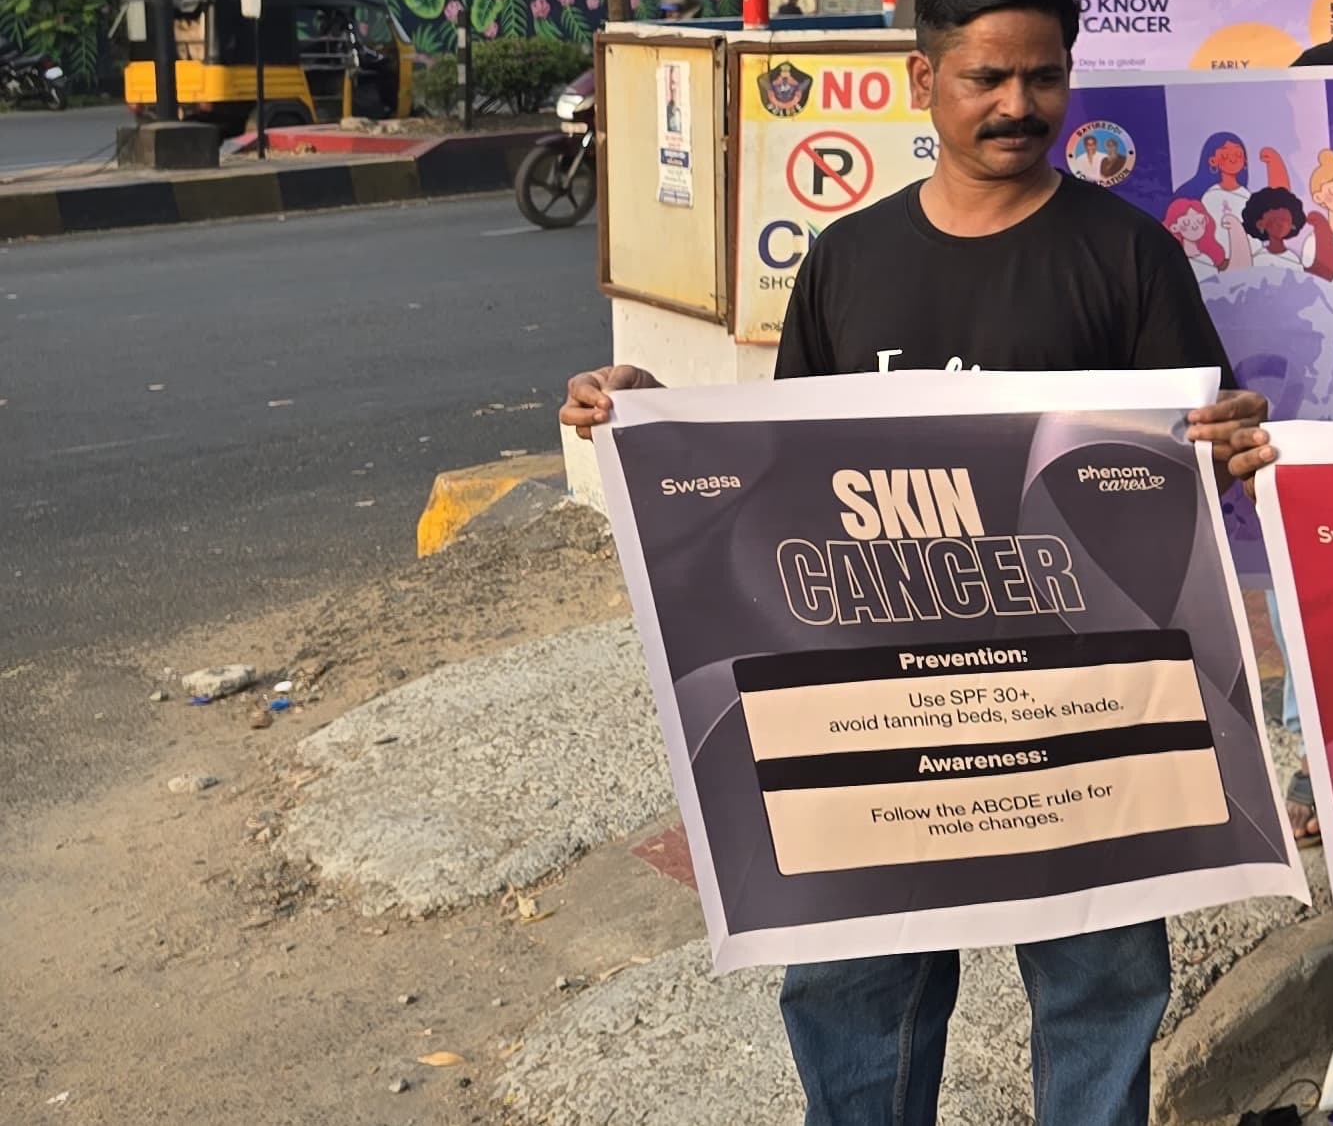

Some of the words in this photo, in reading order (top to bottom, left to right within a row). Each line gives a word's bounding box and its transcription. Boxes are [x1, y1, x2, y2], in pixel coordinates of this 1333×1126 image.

[1083, 16, 1172, 33] CANCER
[821, 70, 892, 110] NO
[661, 475, 741, 495] Swaasa
[1078, 465, 1151, 482] phenom
[1100, 478, 1154, 493] cares
[832, 468, 985, 541] SKIN
[776, 534, 1087, 626] CANCER
[899, 647, 1029, 671] Prevention:
[908, 692, 945, 709] Use
[950, 688, 987, 705] SPF
[993, 686, 1036, 703] 30+,
[829, 714, 879, 733] avoid
[884, 710, 953, 728] tanning
[957, 707, 1008, 725] beds,
[1011, 704, 1057, 722] seek
[1061, 698, 1124, 715] shade.
[918, 748, 1048, 774] Awareness:
[870, 805, 931, 824] Follow
[936, 802, 967, 818] the
[971, 793, 1043, 815] ABCDE
[1046, 787, 1083, 807] rule
[1087, 783, 1113, 800] for
[928, 820, 974, 837] mole
[979, 811, 1064, 832] changes.
